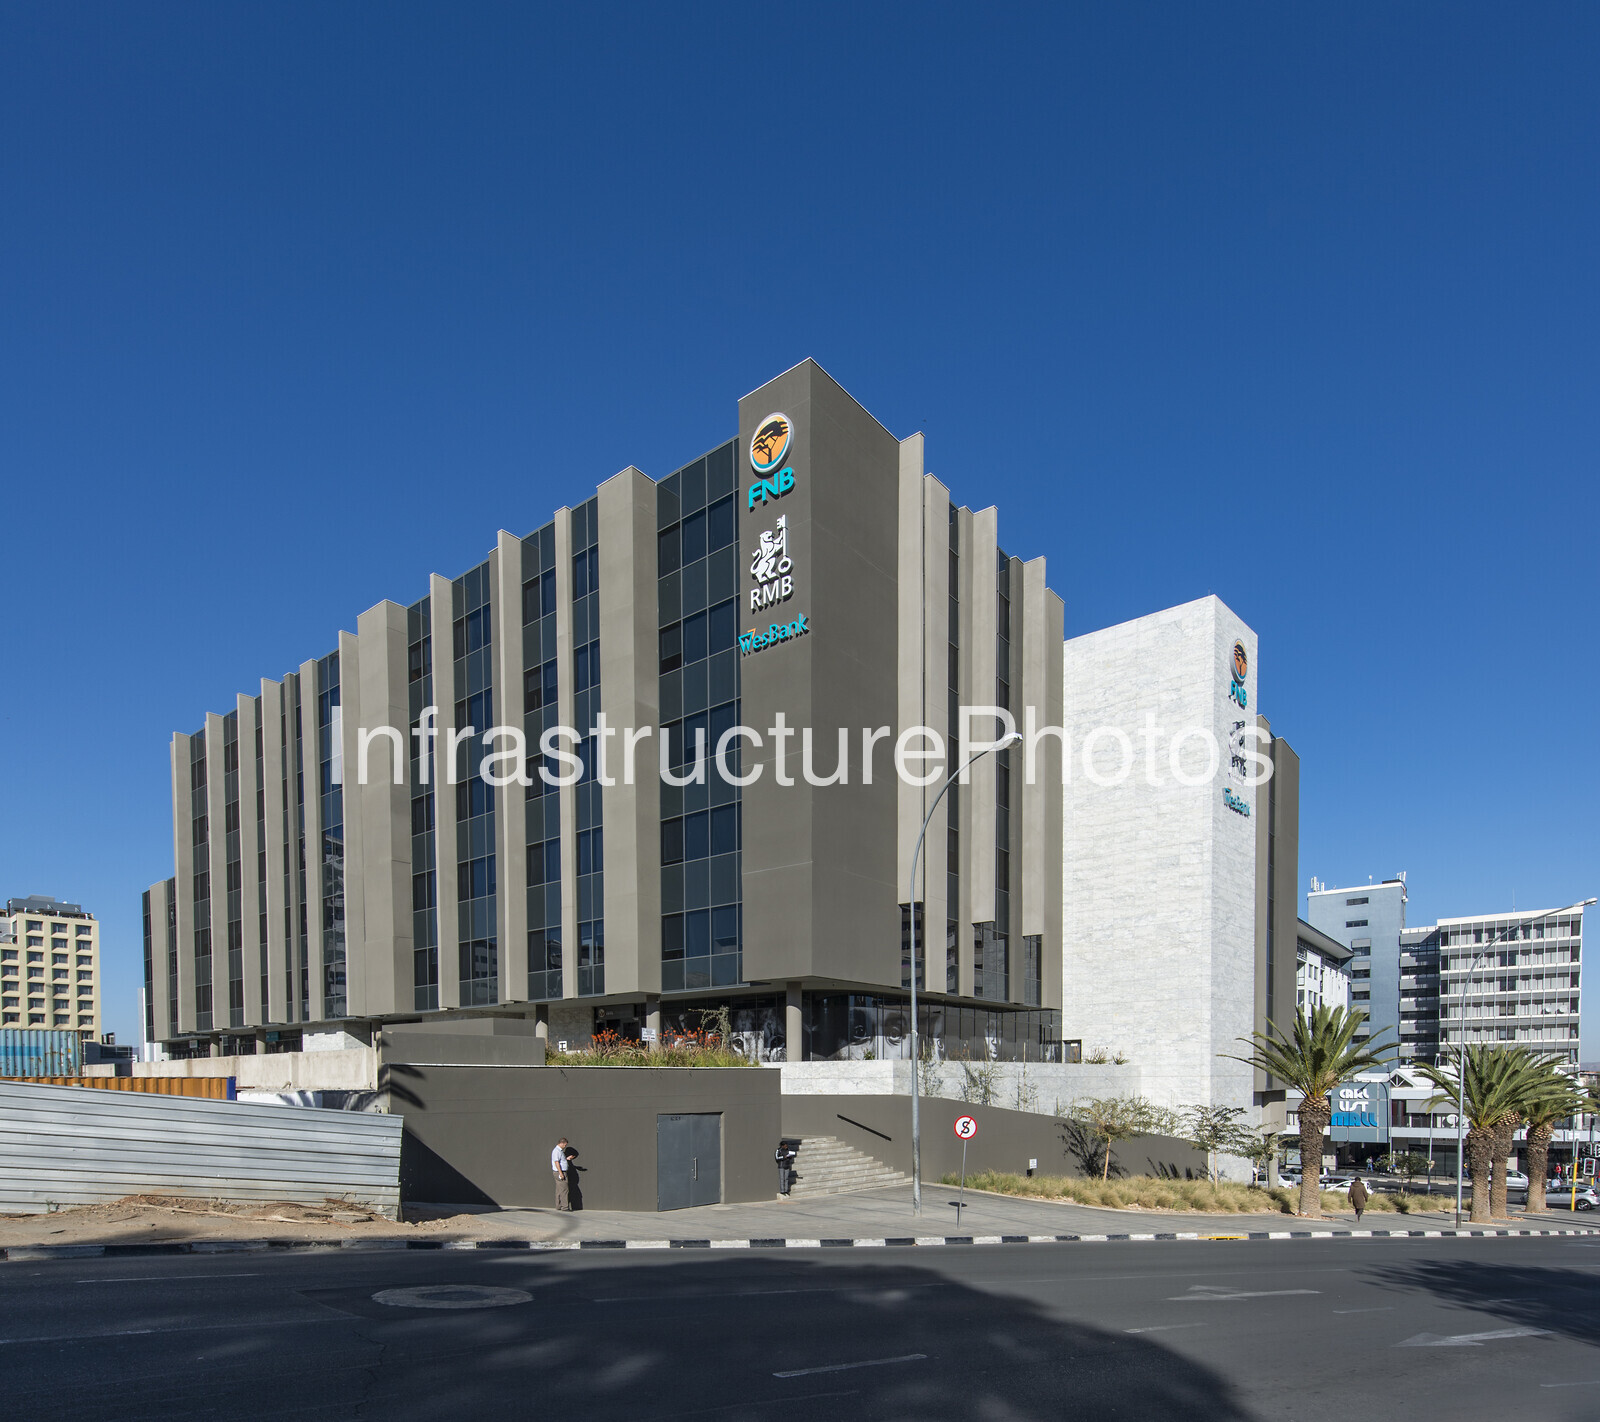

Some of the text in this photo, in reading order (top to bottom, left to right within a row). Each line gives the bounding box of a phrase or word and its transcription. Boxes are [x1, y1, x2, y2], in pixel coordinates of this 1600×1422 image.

[749, 467, 795, 508] FNB
[750, 575, 794, 611] RMB
[738, 613, 809, 654] WesBank
[1230, 680, 1248, 707] FNB
[1339, 1088, 1369, 1099] CARL
[1339, 1101, 1369, 1112] LIST
[1331, 1112, 1378, 1127] MALL
